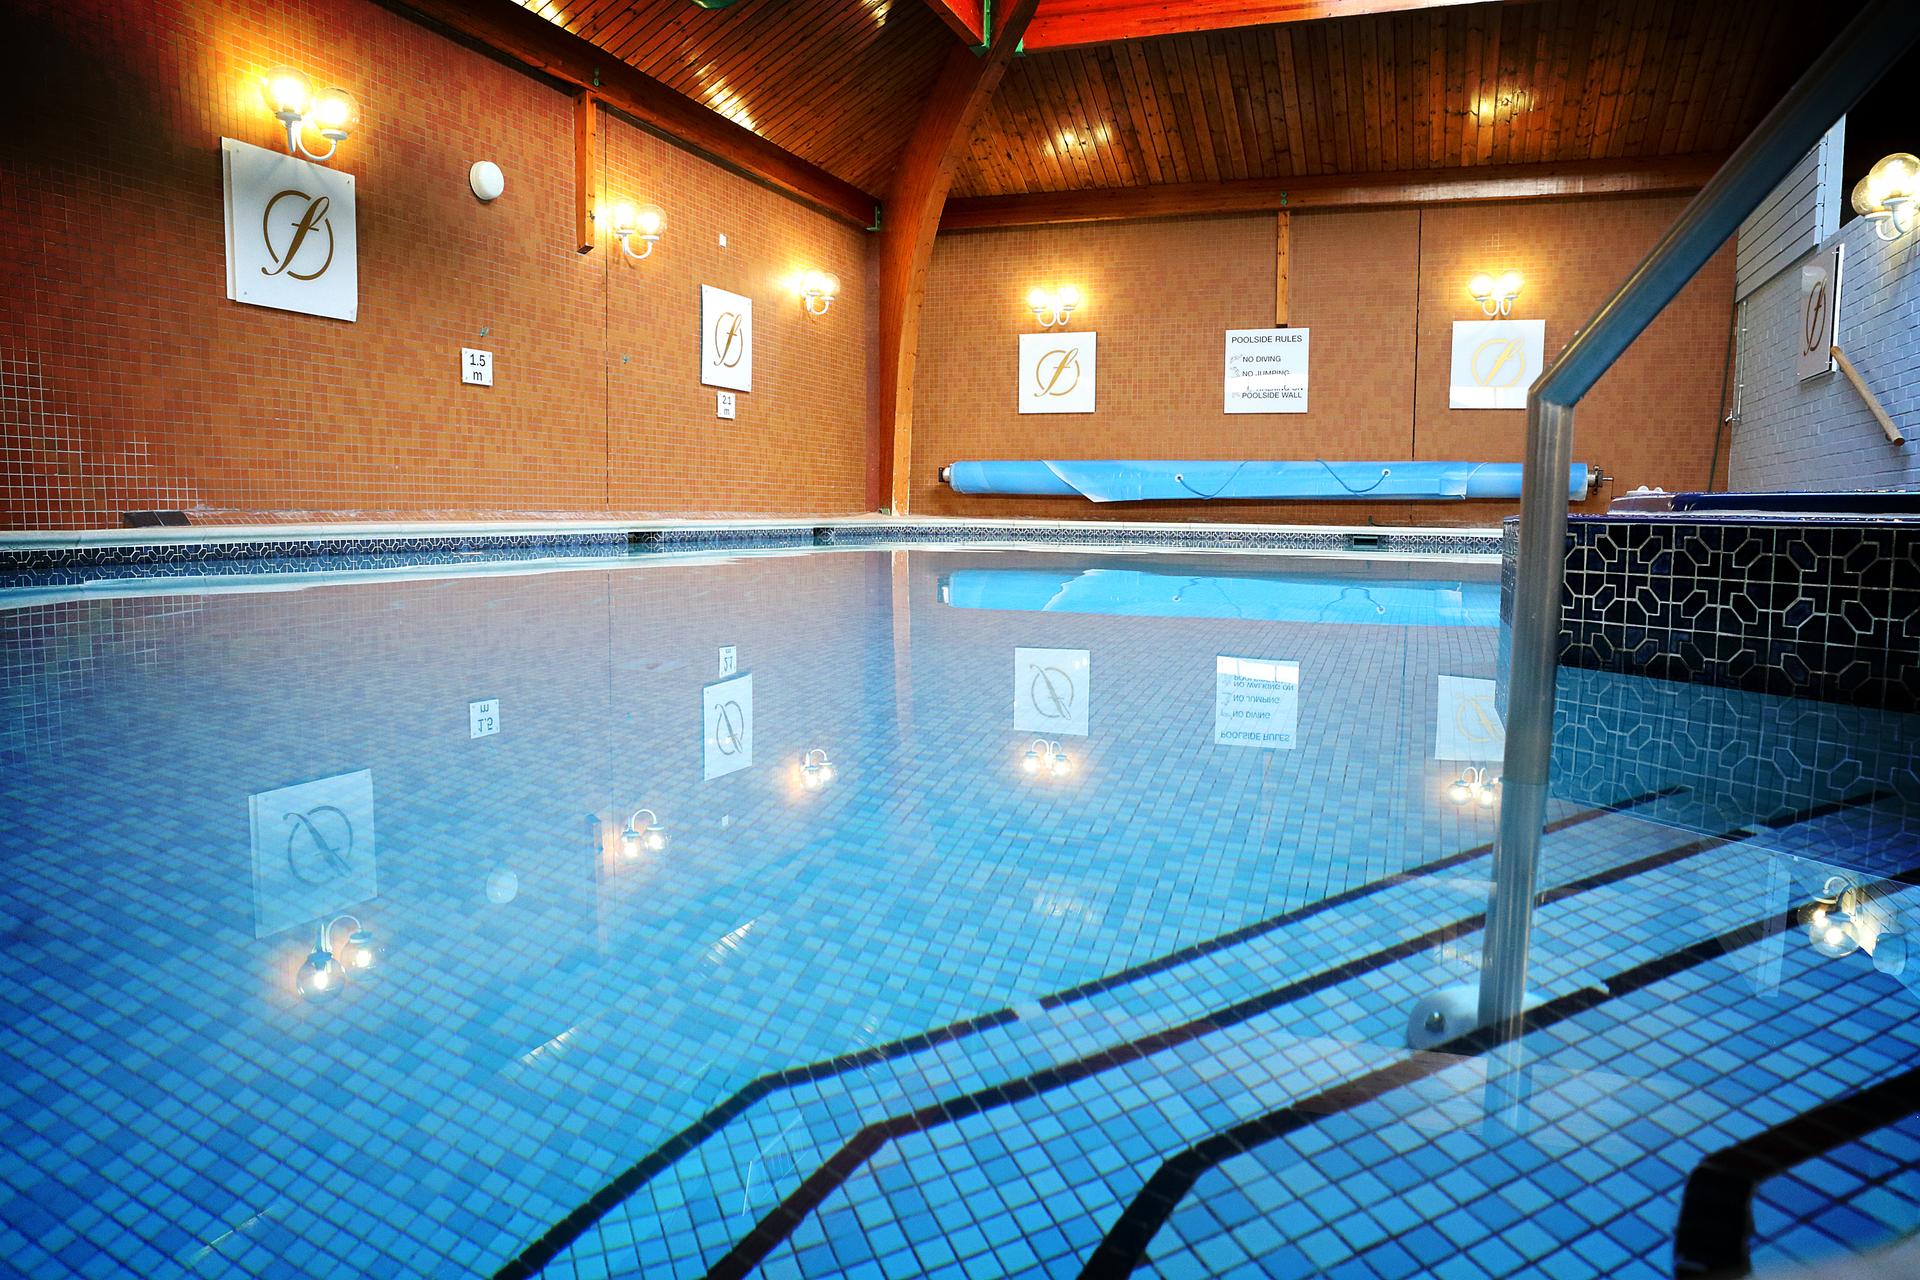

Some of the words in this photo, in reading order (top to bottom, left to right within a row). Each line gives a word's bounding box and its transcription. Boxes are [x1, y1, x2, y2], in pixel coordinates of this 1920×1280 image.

[1231, 335, 1272, 344] POOLSIDE
[1275, 334, 1303, 343] RULES
[470, 353, 486, 367] 1.5
[1255, 355, 1282, 363] DIVING
[473, 371, 483, 381] m
[1241, 391, 1280, 399] POOLSIDE
[1281, 391, 1303, 399] WALL
